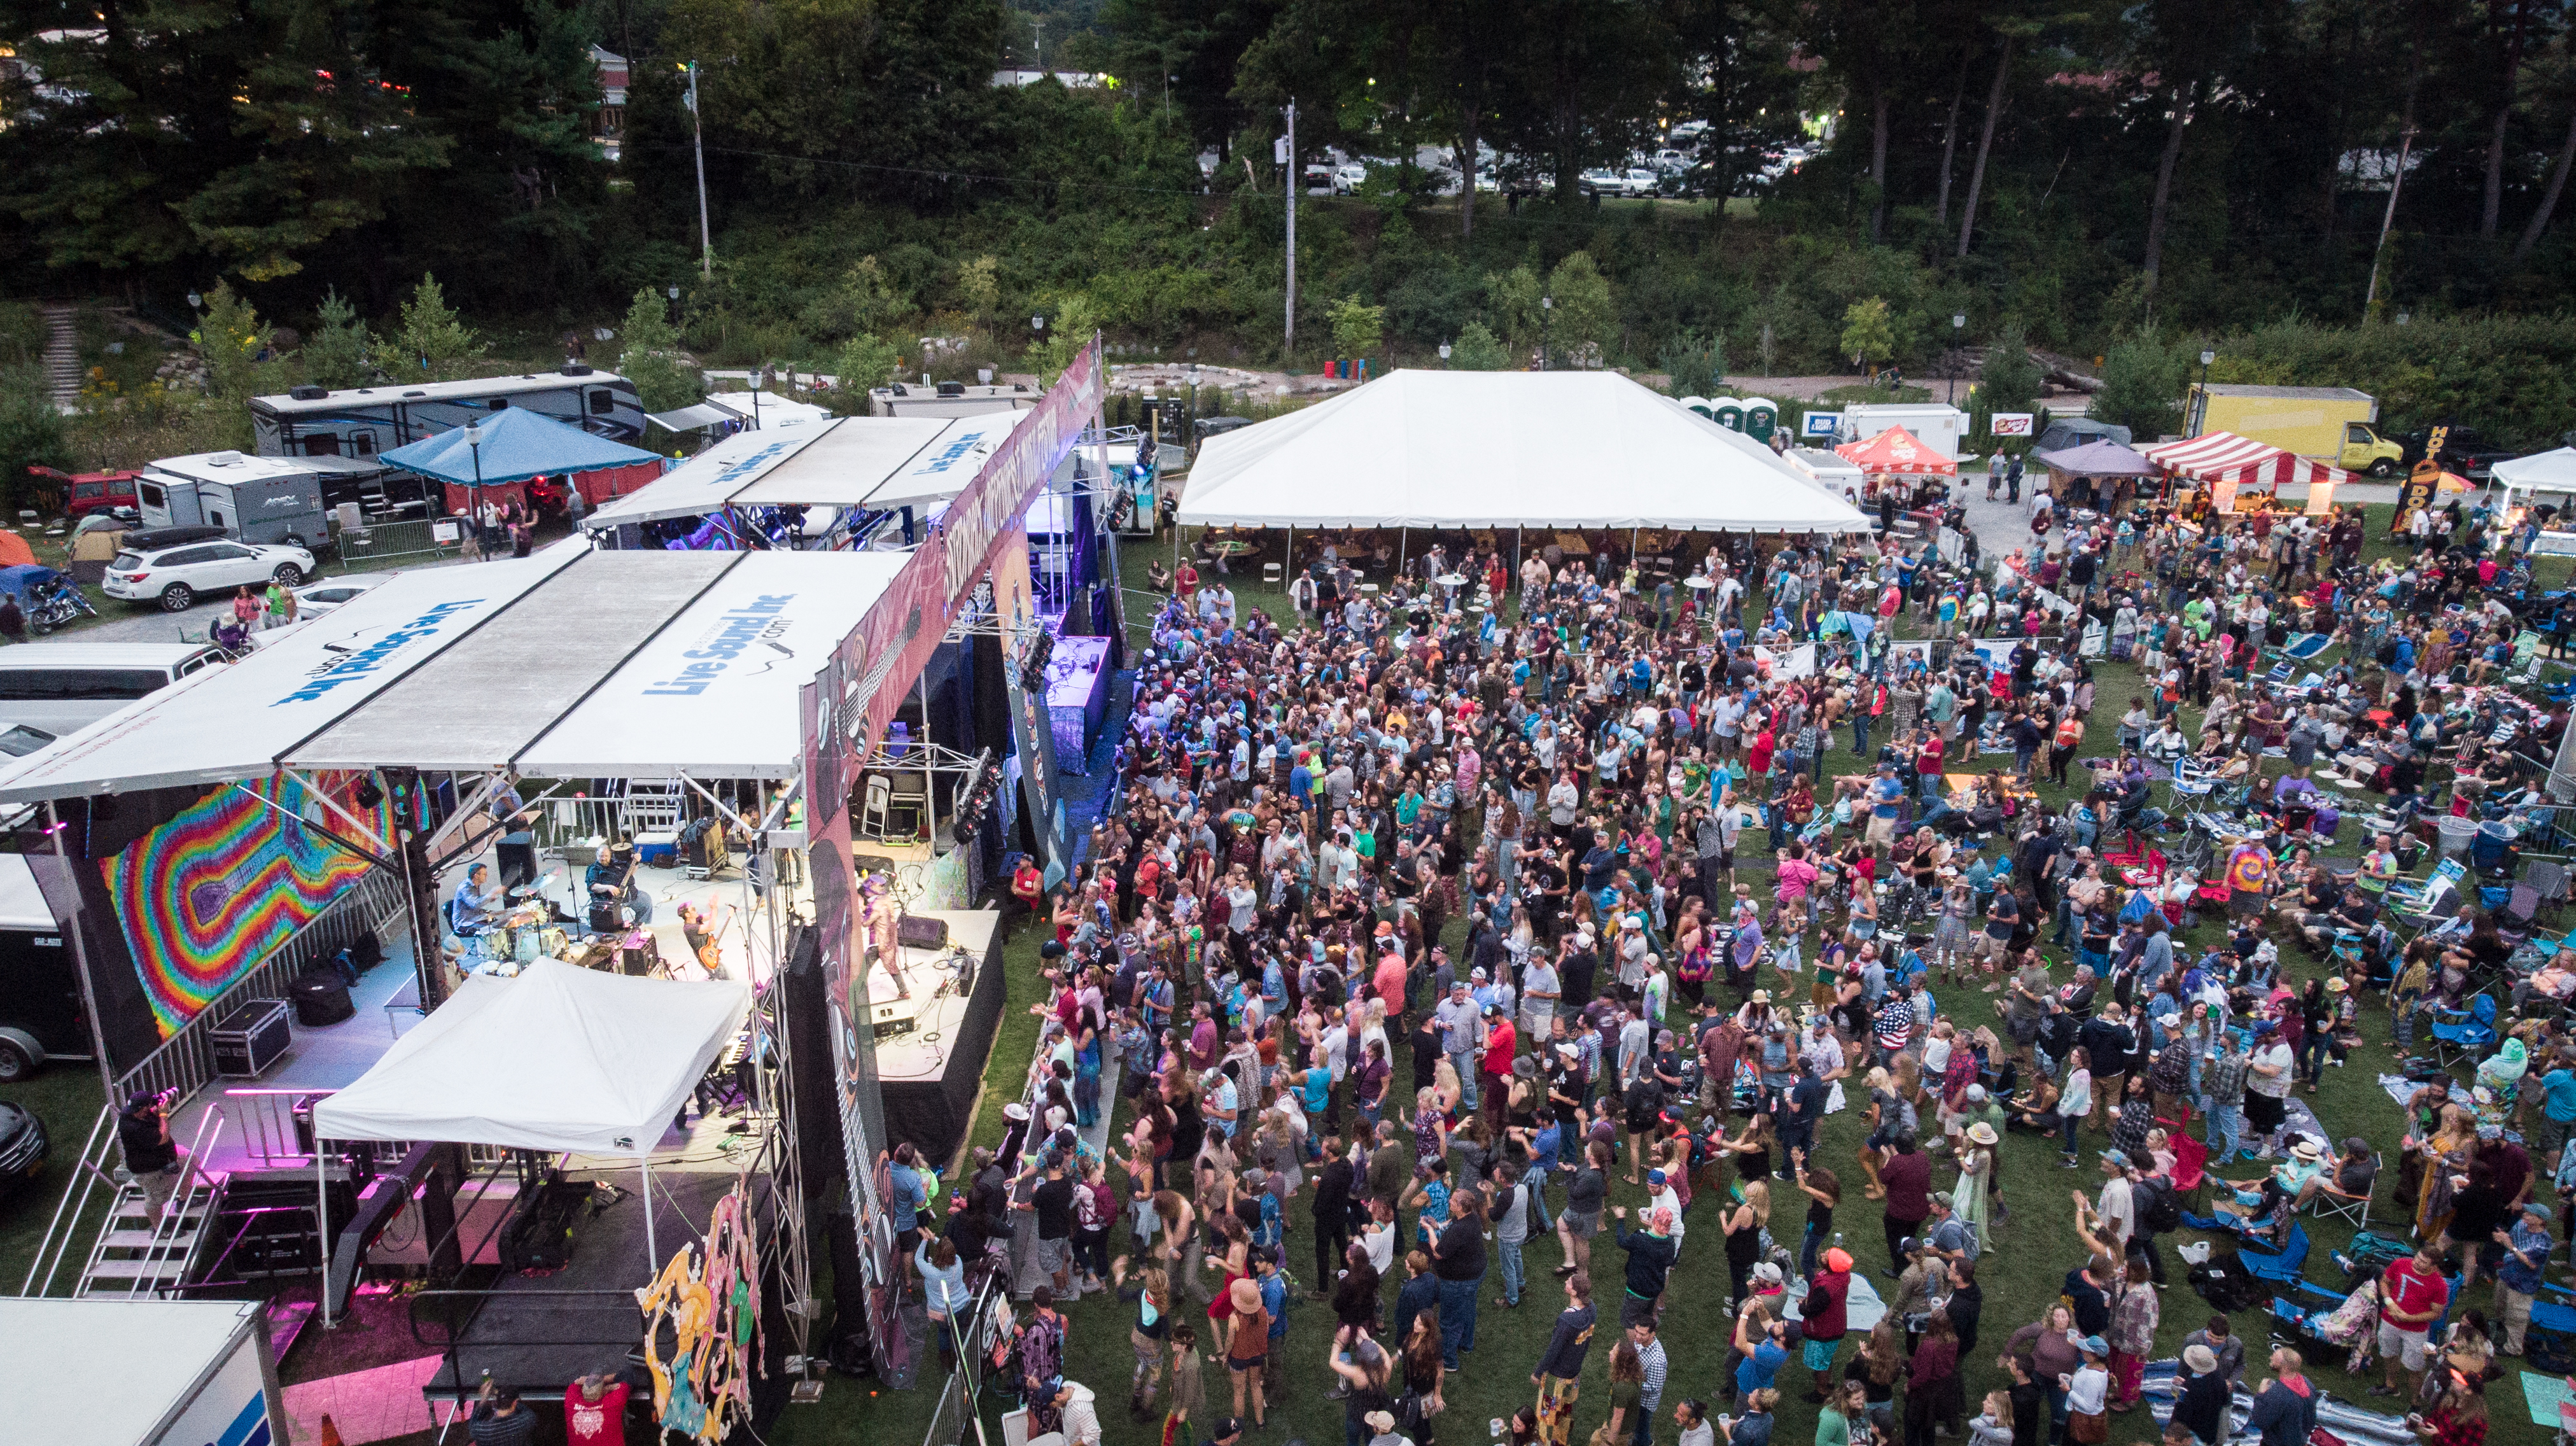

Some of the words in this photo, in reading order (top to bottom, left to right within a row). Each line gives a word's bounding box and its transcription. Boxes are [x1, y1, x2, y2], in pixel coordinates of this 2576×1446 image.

[2425, 426, 2449, 460] HOT
[402, 598, 489, 629] Live
[641, 661, 728, 695] Live
